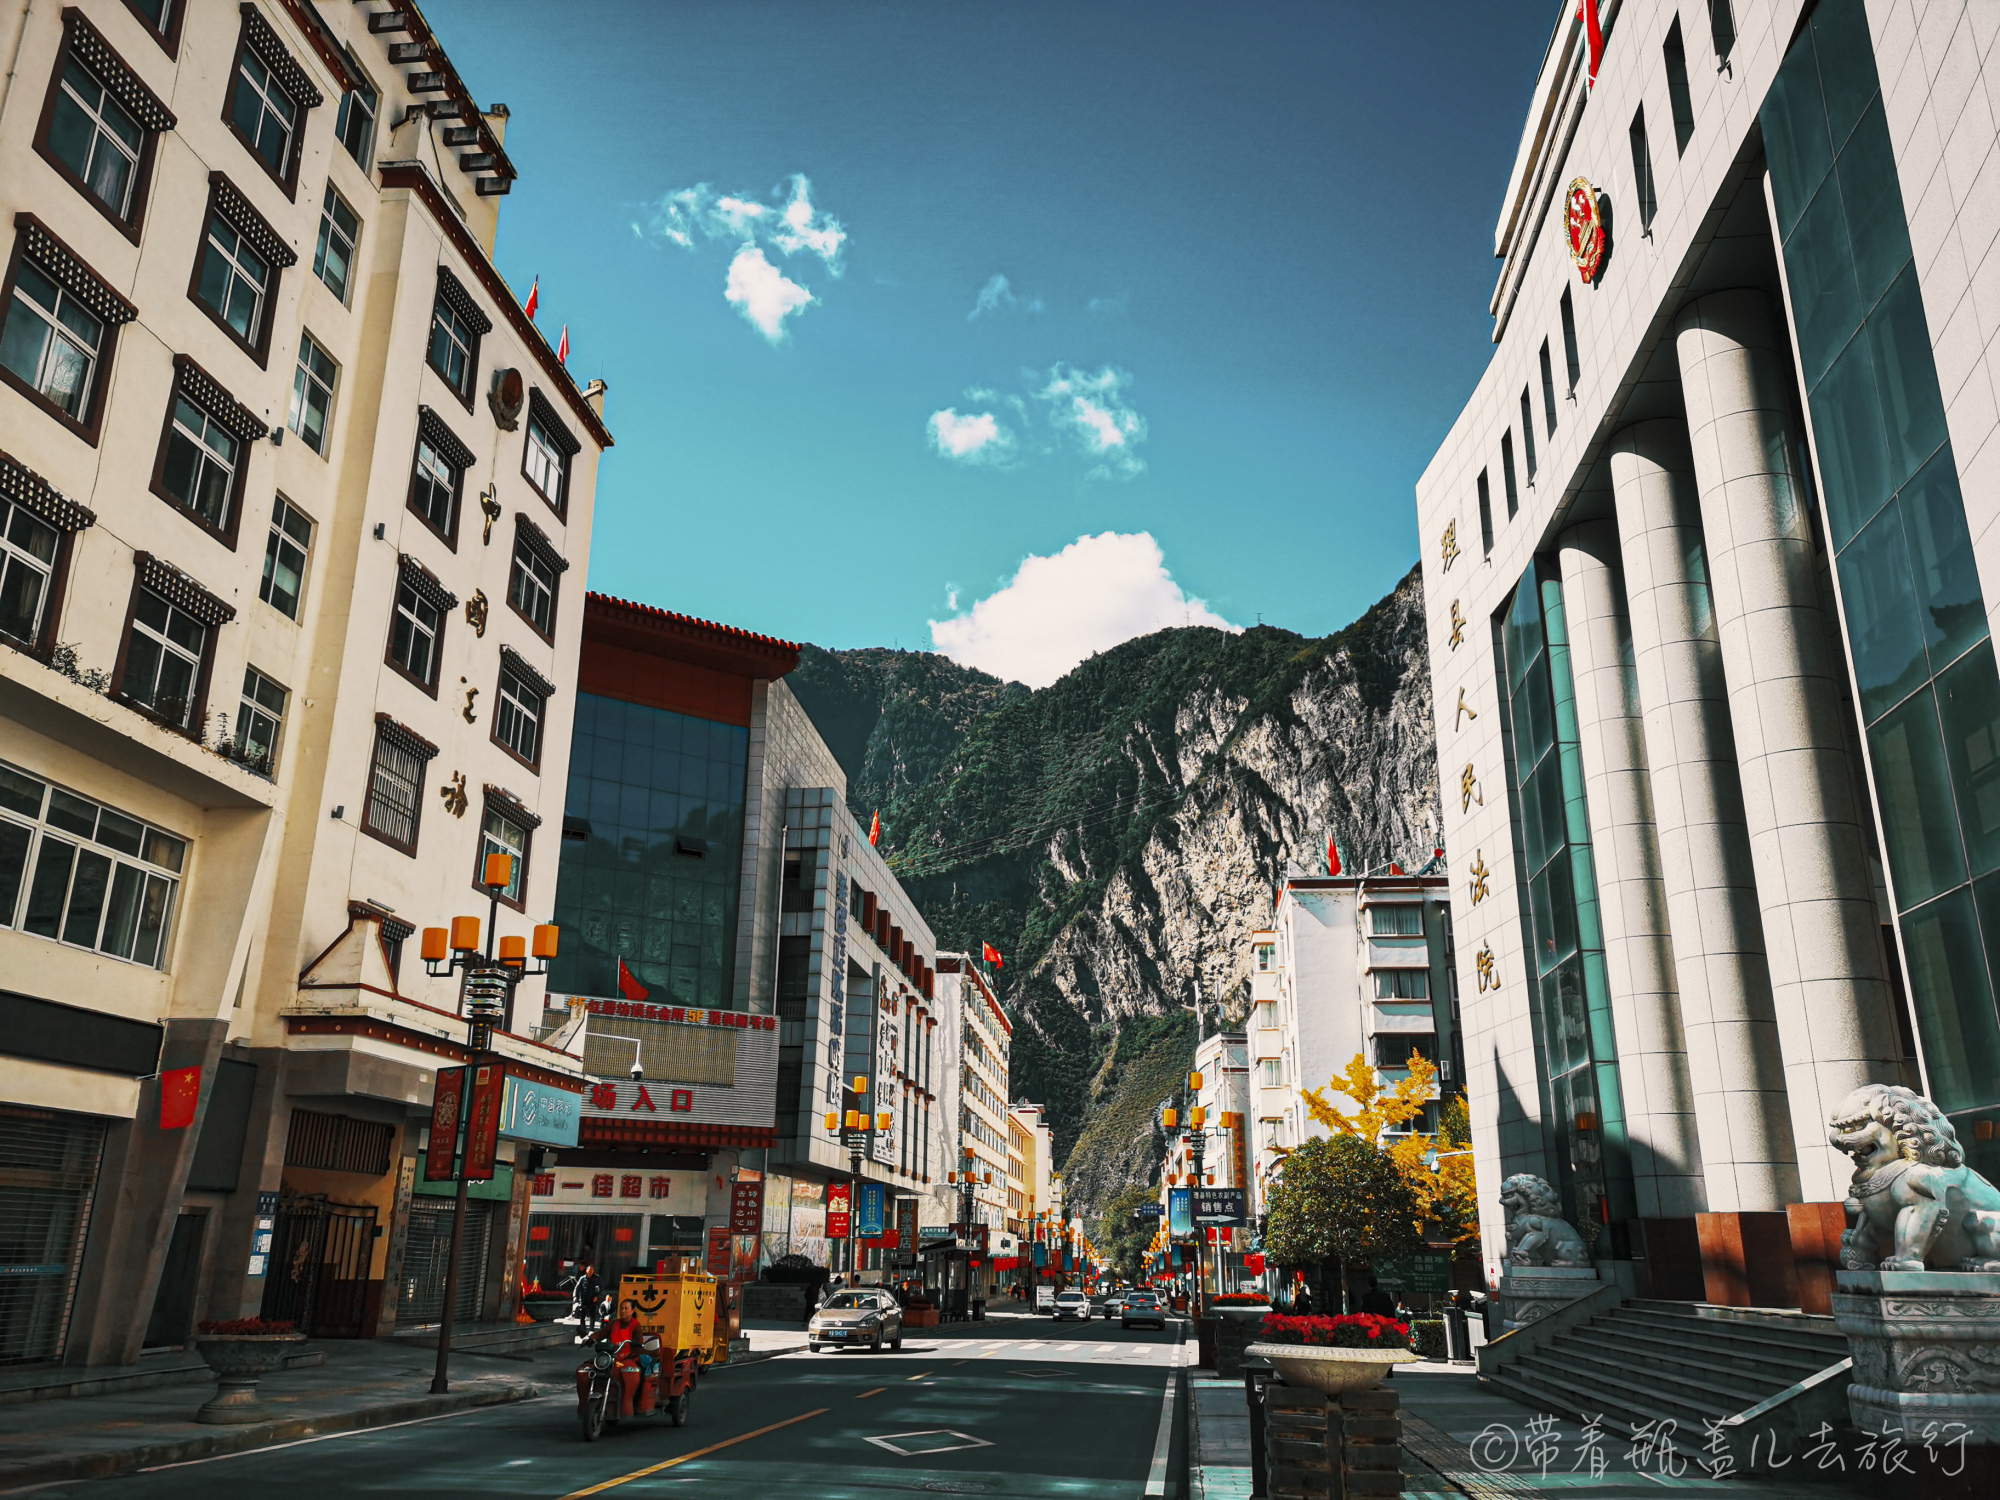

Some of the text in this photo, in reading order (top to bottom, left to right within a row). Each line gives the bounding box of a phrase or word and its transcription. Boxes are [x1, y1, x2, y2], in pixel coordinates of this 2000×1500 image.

[1440, 516, 1501, 994] 理县人民法院
[688, 1009, 704, 1022] 5F
[590, 1083, 693, 1112] 场入口
[531, 1173, 671, 1199] 新一佳超市
[1193, 1191, 1242, 1199] 理县特色农副产品
[1201, 1201, 1235, 1213] 销售点
[900, 1200, 913, 1249] 印象酒店
[1414, 1264, 1434, 1272] 场所
